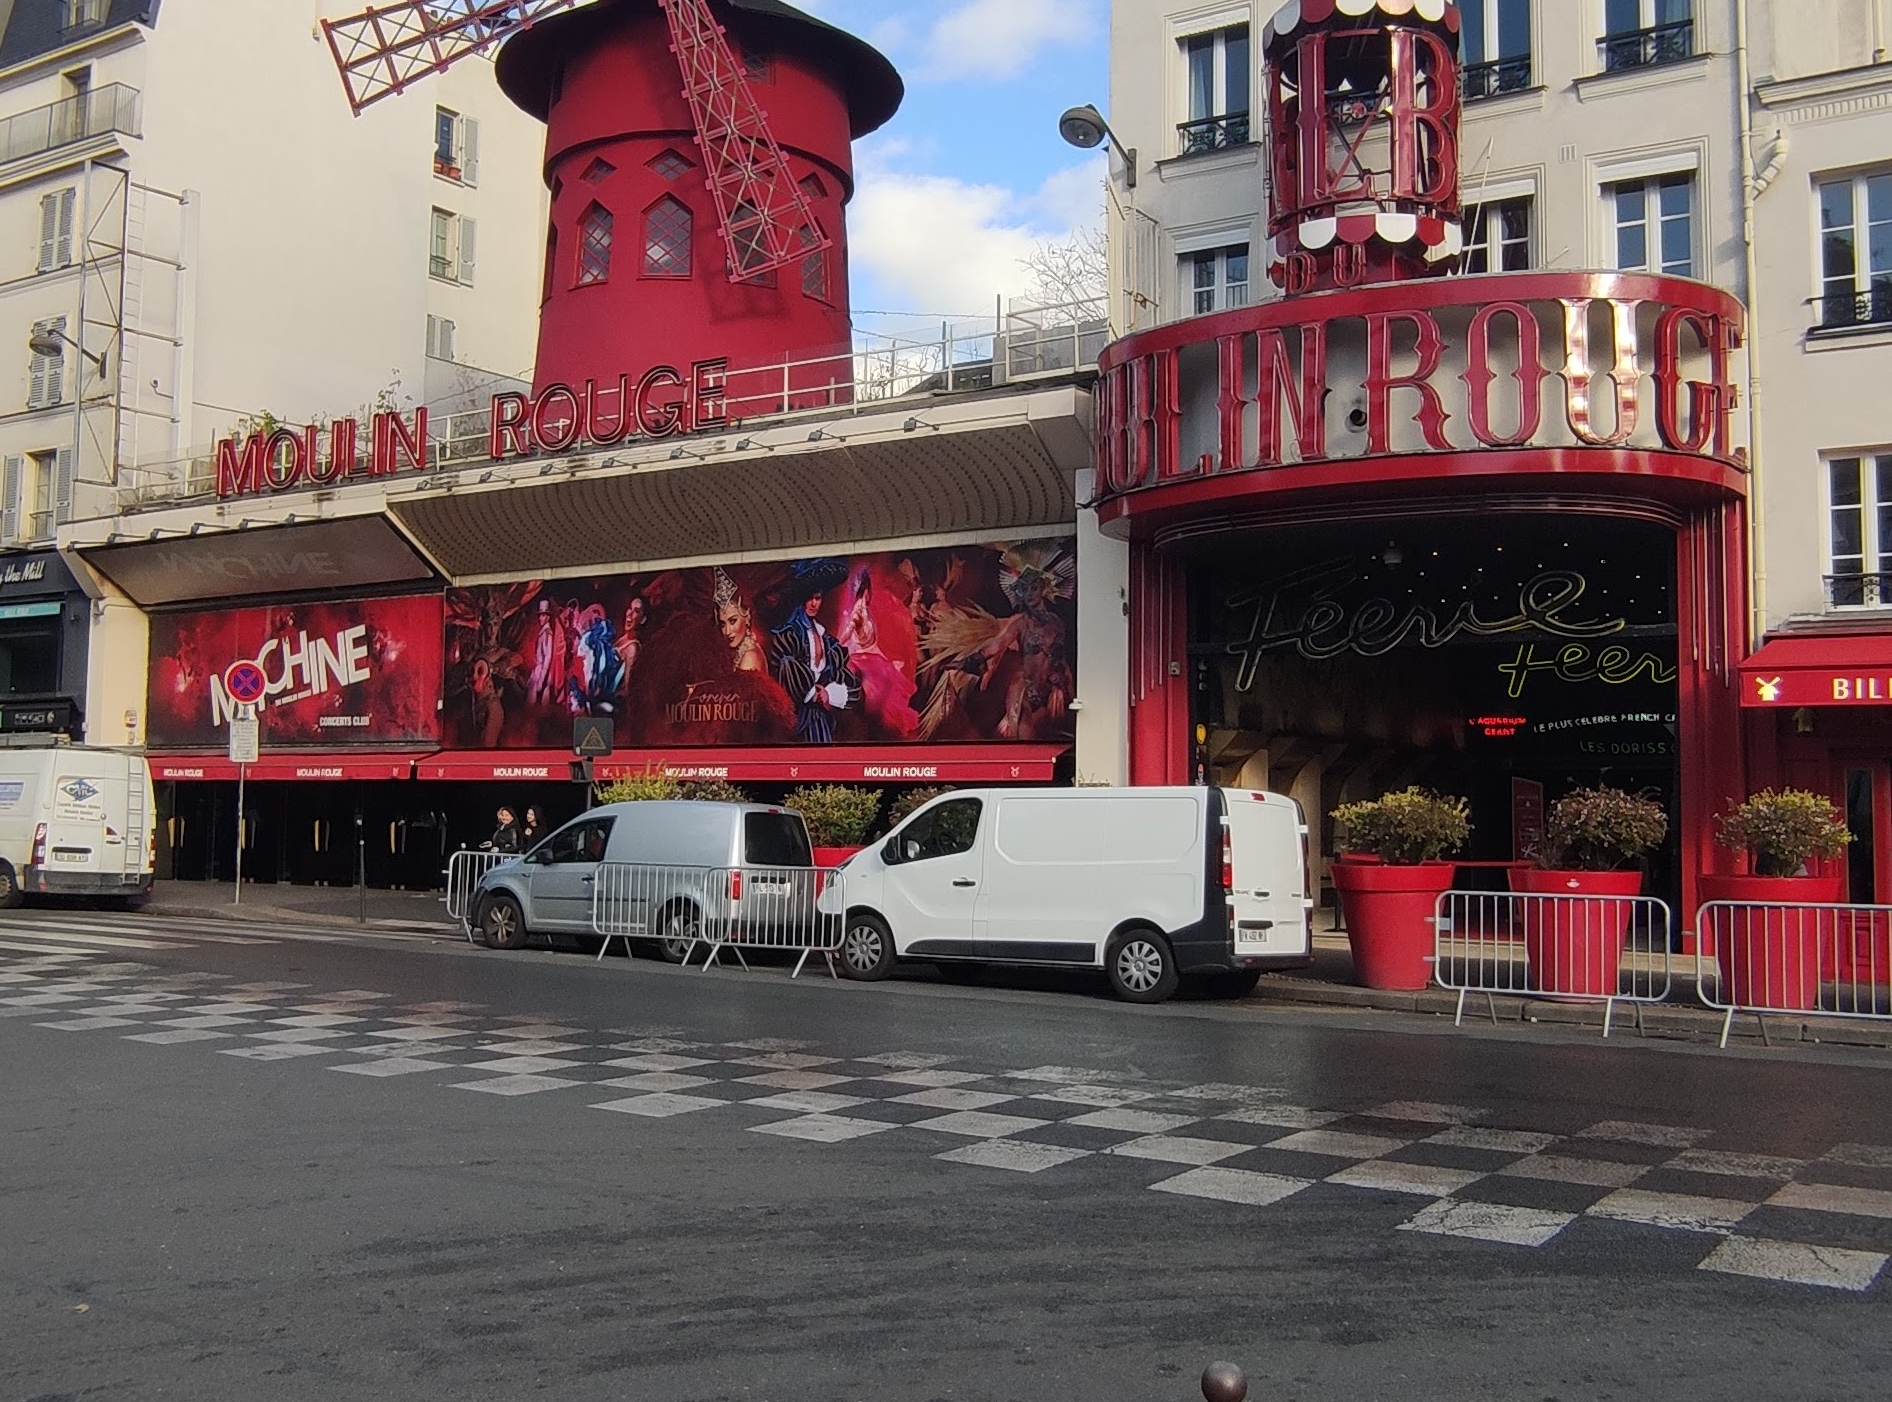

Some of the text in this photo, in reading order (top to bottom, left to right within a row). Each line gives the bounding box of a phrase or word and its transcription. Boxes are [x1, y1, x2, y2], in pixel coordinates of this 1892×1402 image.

[216, 356, 730, 497] MOULIN ROUGE
[21, 560, 46, 582] Mill
[209, 624, 371, 727] MCHINE
[1832, 677, 1892, 700] BIL
[665, 700, 760, 724] MOULIN ROUGE
[1548, 719, 1575, 731] PLUS
[1580, 740, 1606, 753] LES
[1611, 741, 1667, 755] DORISS
[296, 768, 343, 777] MOULIN ROUGE
[493, 767, 549, 777] MOULIN ROUGE
[698, 767, 729, 777] ROUGE
[863, 766, 938, 778] MOULIN ROUGE
